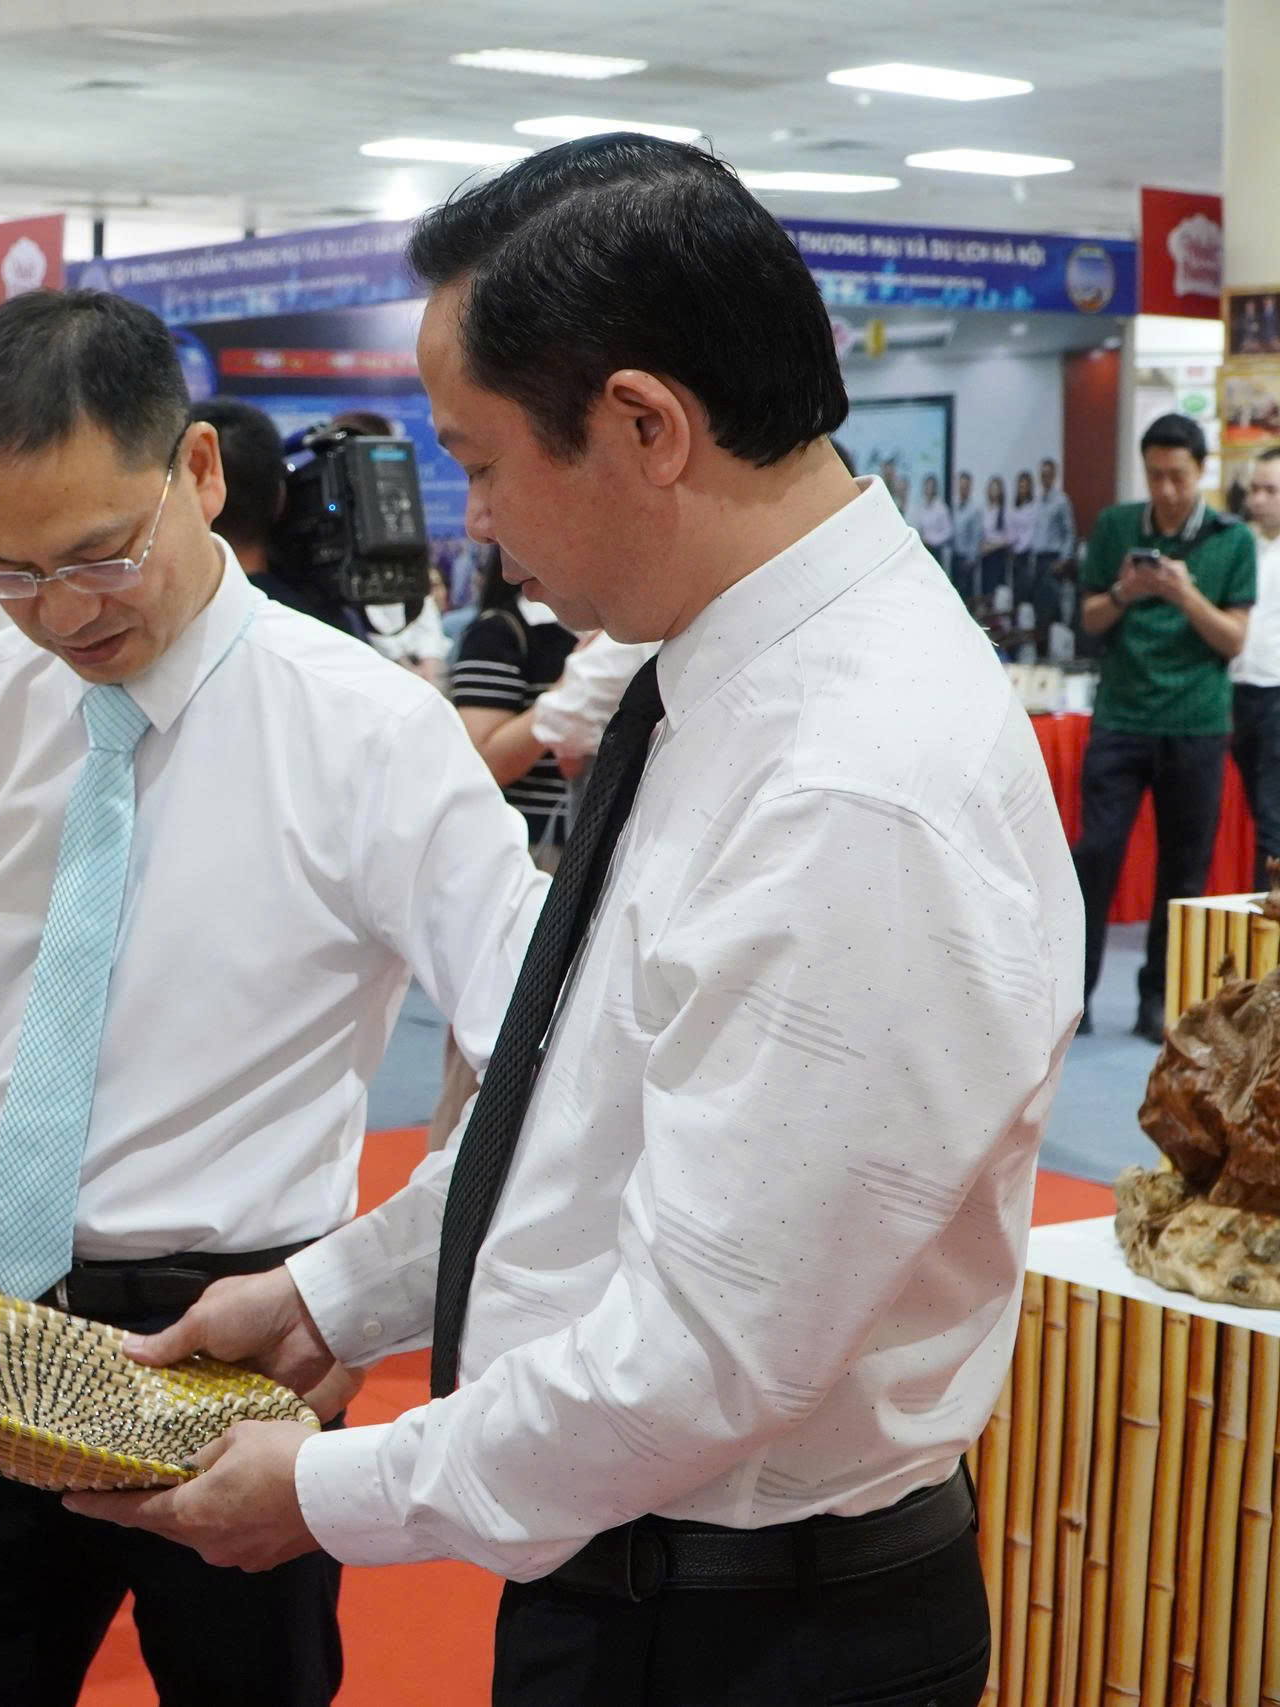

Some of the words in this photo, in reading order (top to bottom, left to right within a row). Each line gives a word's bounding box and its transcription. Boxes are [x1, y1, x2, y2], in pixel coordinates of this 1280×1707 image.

[798, 230, 867, 256] THƯƠNG
[870, 234, 902, 259] MẠI
[905, 232, 927, 259] VÀ
[930, 238, 953, 261] DU
[956, 239, 987, 265] LỊCH
[992, 238, 1017, 265] HÀ
[1018, 239, 1047, 269] NỘI
